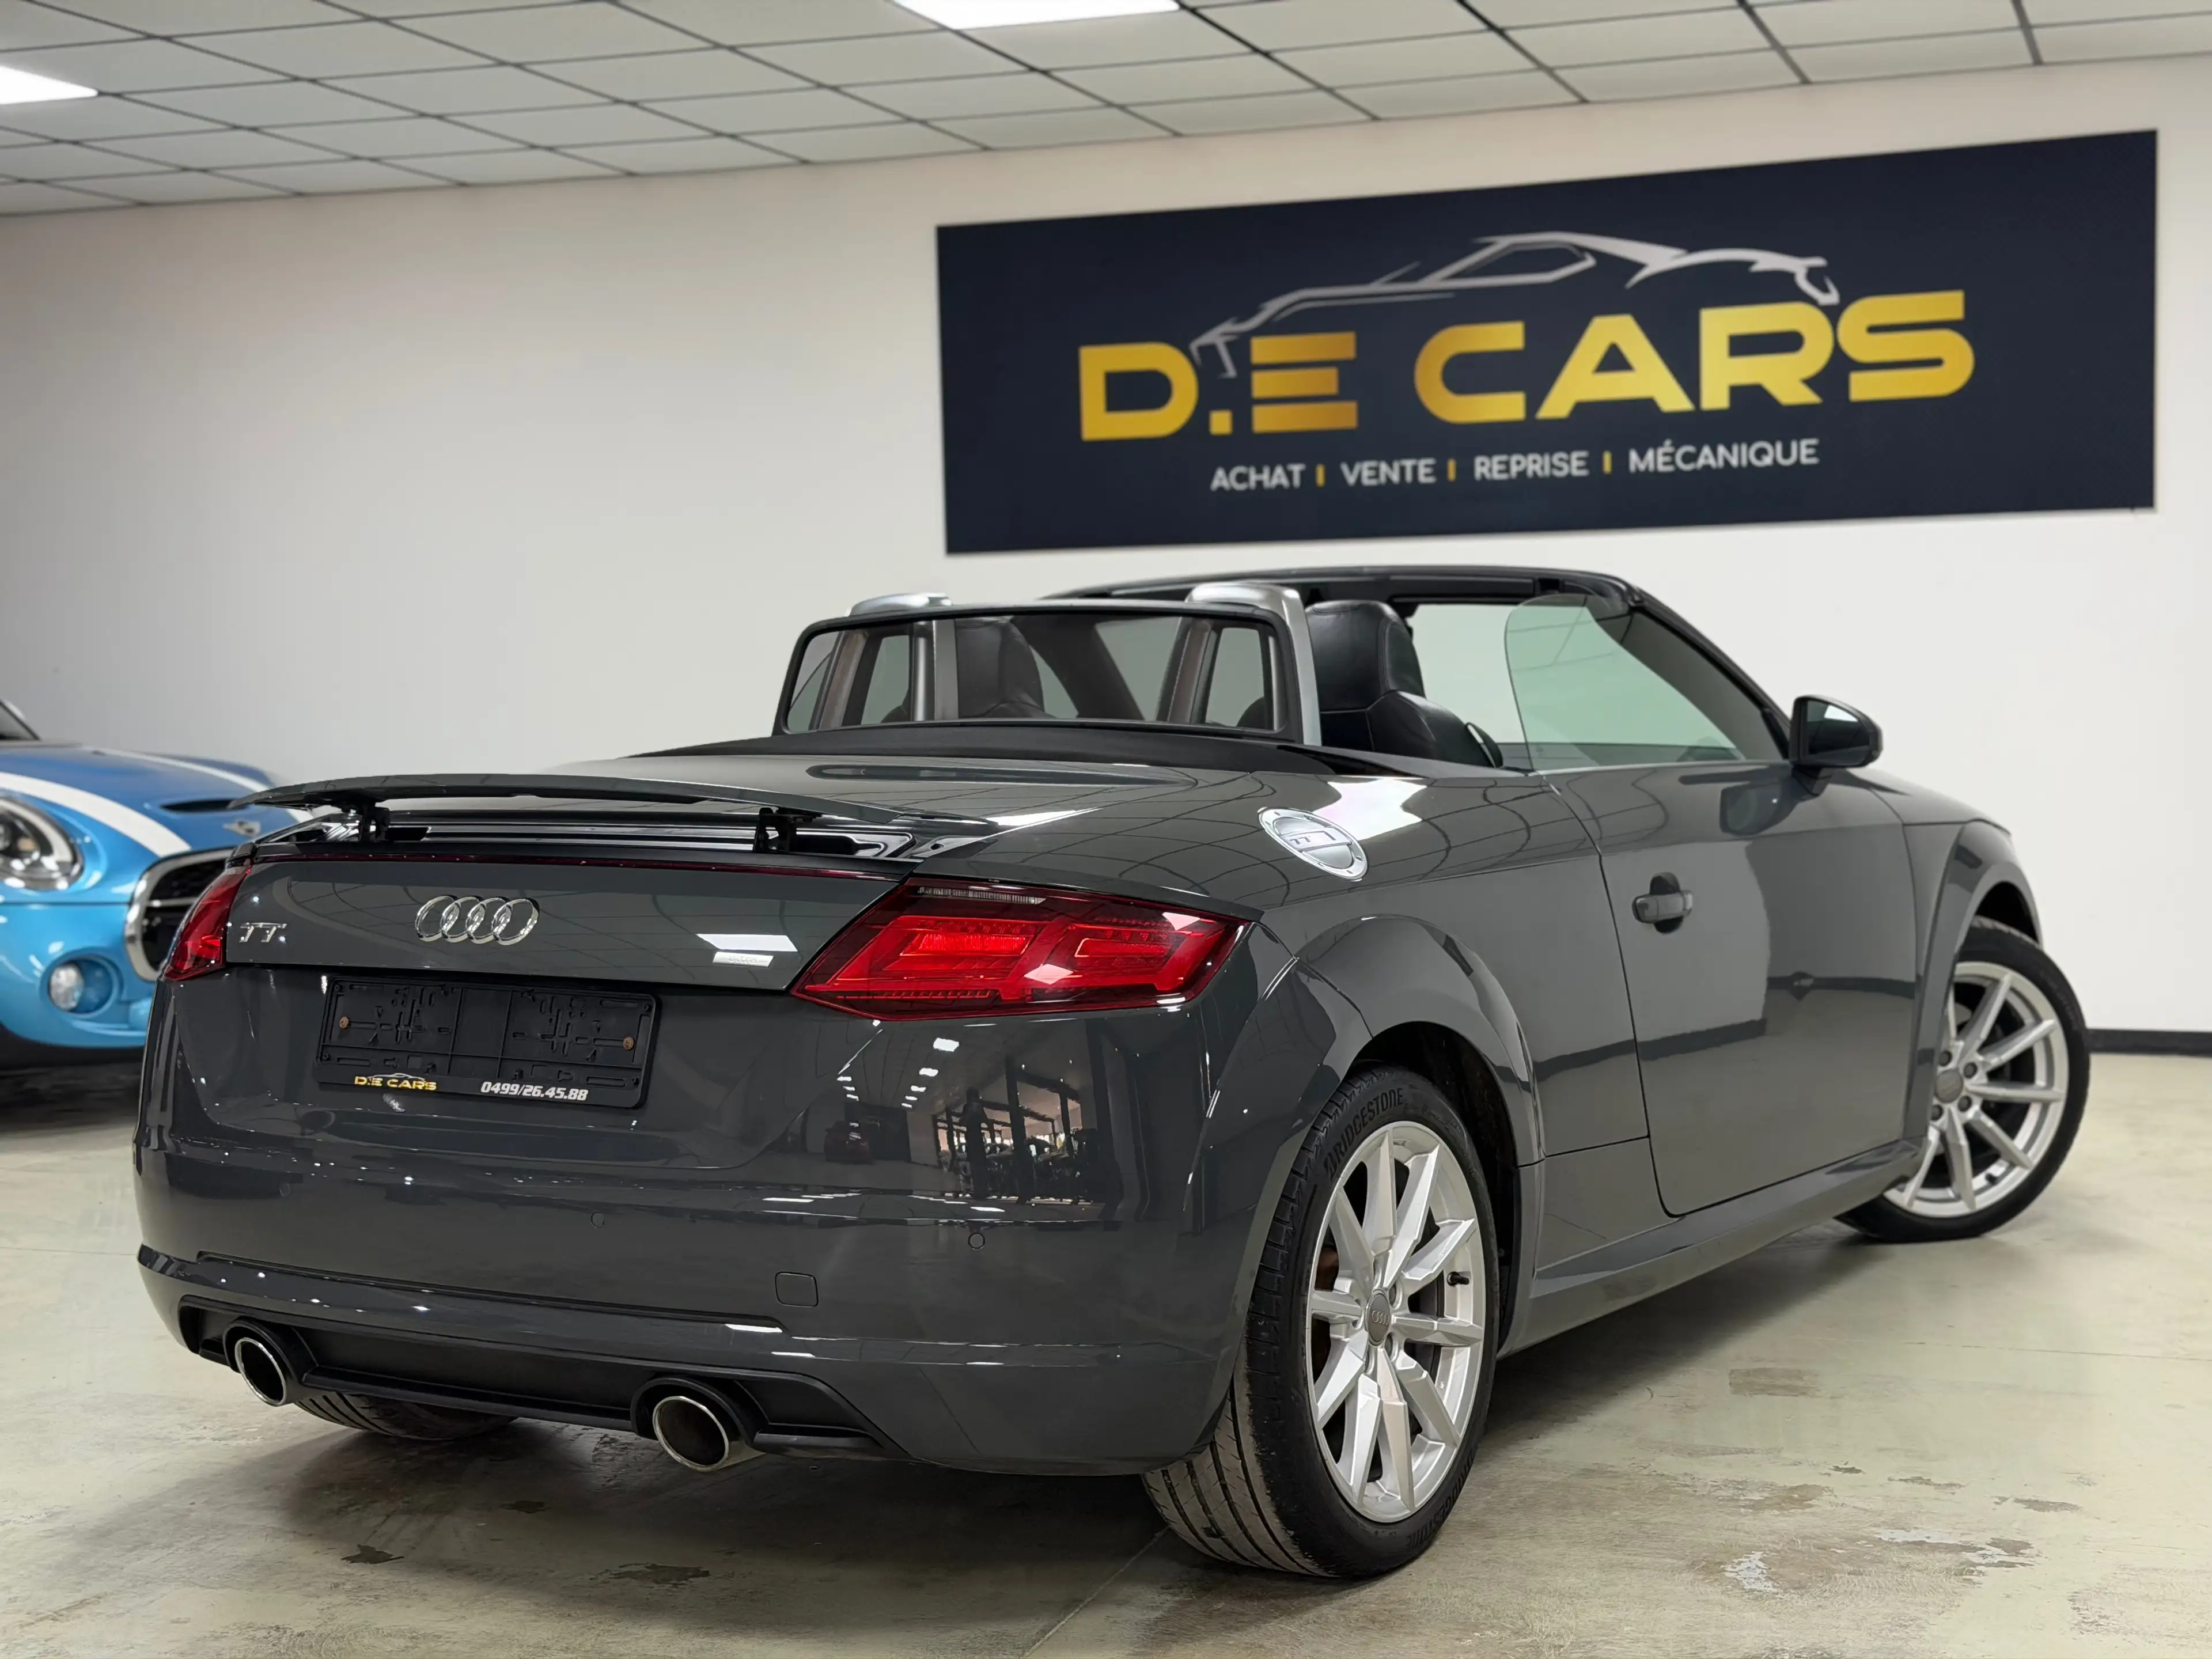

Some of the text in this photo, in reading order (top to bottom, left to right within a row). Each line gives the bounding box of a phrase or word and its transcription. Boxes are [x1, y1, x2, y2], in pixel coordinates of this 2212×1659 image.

[1079, 290, 1976, 441] D.E CARS
[1210, 438, 1820, 491] ACHAT VENTE REPRISE MÉCANIQUE
[239, 922, 287, 943] TT
[387, 1078, 437, 1090] CARS
[480, 1081, 589, 1101] 0499/26.45.88
[1323, 1086, 1404, 1184] BRIDGESTONE
